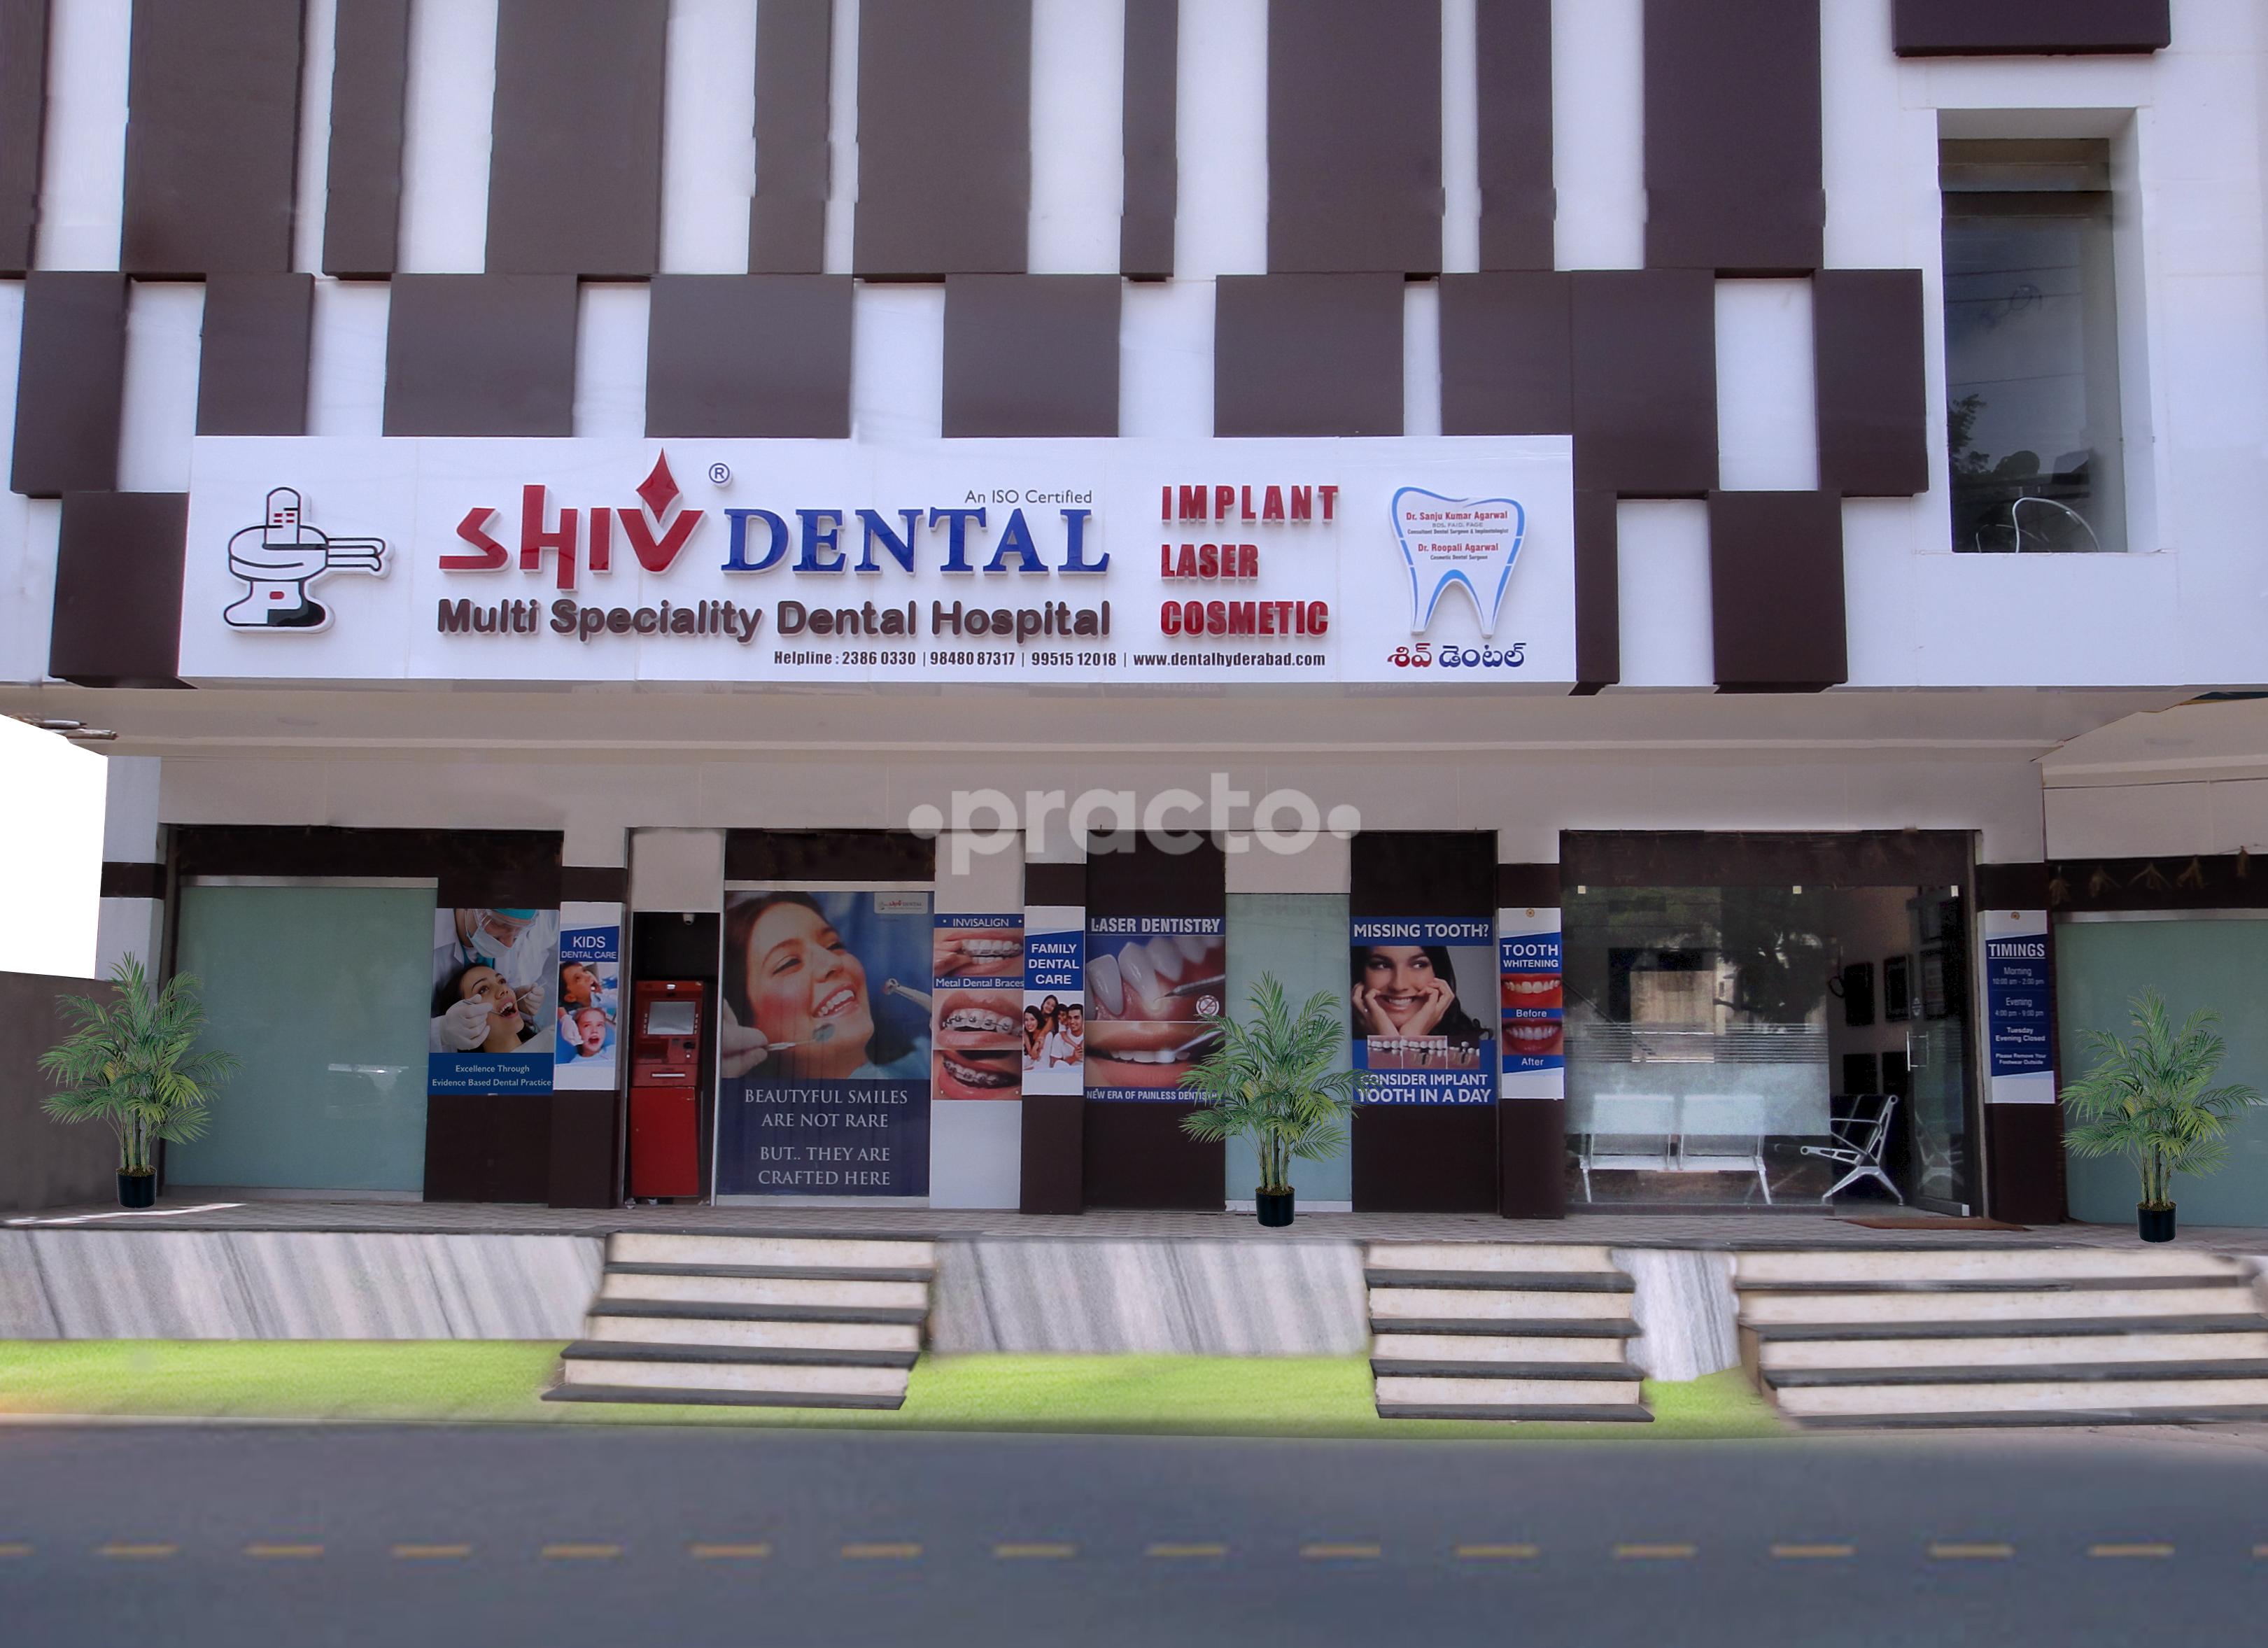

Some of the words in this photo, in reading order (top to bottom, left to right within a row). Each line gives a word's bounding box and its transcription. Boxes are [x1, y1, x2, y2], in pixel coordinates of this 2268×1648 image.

[964, 489, 986, 503] An
[992, 489, 1020, 503] ISO
[1025, 488, 1092, 503] Certified
[1161, 485, 1339, 521] IMPLANT
[1406, 512, 1417, 520] Dr.
[1420, 512, 1443, 521] Sanju
[1445, 512, 1472, 520] Kumar
[1474, 511, 1508, 521] Agarwal
[720, 507, 1111, 573] DENTAL
[1418, 543, 1429, 551] Dr.
[1431, 543, 1463, 553] Roopali
[1465, 542, 1499, 553] Agarwal
[1161, 544, 1259, 578] LASER
[437, 598, 538, 635] Multi
[550, 598, 763, 644] Speciality
[777, 600, 917, 635] Dental
[931, 600, 1111, 644] Hospital
[1160, 600, 1330, 635] COSMETIC
[842, 652, 877, 665] 2386
[880, 652, 916, 665] 0330
[930, 652, 974, 665] 98480
[977, 652, 1015, 665] 87317
[1031, 652, 1073, 665] 99515
[1077, 652, 1117, 665] 12018
[1133, 652, 1326, 667] www.dentalhyderabad.com
[1387, 642, 1432, 668] శివ్
[1439, 642, 1527, 668] డెంటల్
[952, 918, 1009, 927] INVISALIGN
[1090, 917, 1136, 933] LASER
[1141, 918, 1220, 933] DENTISTRY
[1353, 924, 1421, 938] MISSING
[1425, 924, 1489, 938] TOOTH?
[572, 936, 606, 948] KIDS
[561, 950, 593, 959] DENTAL
[594, 950, 617, 959] CARE
[1031, 943, 1078, 954] FAMILY
[1502, 944, 1559, 957] TOOTH
[1988, 943, 2045, 957] TIMINGS
[1028, 959, 1080, 969] DENTAL
[1503, 959, 1559, 969] WHITENING
[2003, 966, 2032, 976] Morning
[936, 978, 961, 987] Metal
[963, 978, 992, 987] Dental
[995, 978, 1024, 987] Braces
[1035, 974, 1072, 985] CARE
[2006, 997, 2033, 1007] Evening
[1515, 1009, 1547, 1017] Before
[1521, 1057, 1544, 1066] After
[497, 1064, 530, 1073] Through
[1360, 1073, 1427, 1085] CONSIDER
[1430, 1073, 1488, 1085] IMPLANT
[745, 1089, 843, 1104] BEAUTYFUL
[847, 1090, 908, 1104] SMILES
[1086, 1090, 1105, 1099] NEW
[1107, 1090, 1123, 1099] ERA
[1125, 1090, 1136, 1099] OF
[1138, 1090, 1176, 1100] PAINLESS
[1358, 1088, 1415, 1103] TOOTH
[1420, 1088, 1437, 1103] IN
[1442, 1088, 1455, 1103] A
[1458, 1088, 1491, 1103] DAY
[761, 1113, 794, 1127] ARE
[800, 1113, 840, 1127] NOT
[845, 1113, 889, 1127] RARE
[760, 1146, 801, 1160] BUT..
[805, 1147, 854, 1161] THEY
[857, 1147, 890, 1162] ARE
[758, 1170, 838, 1184] CRAFTED
[845, 1171, 891, 1185] HERE
